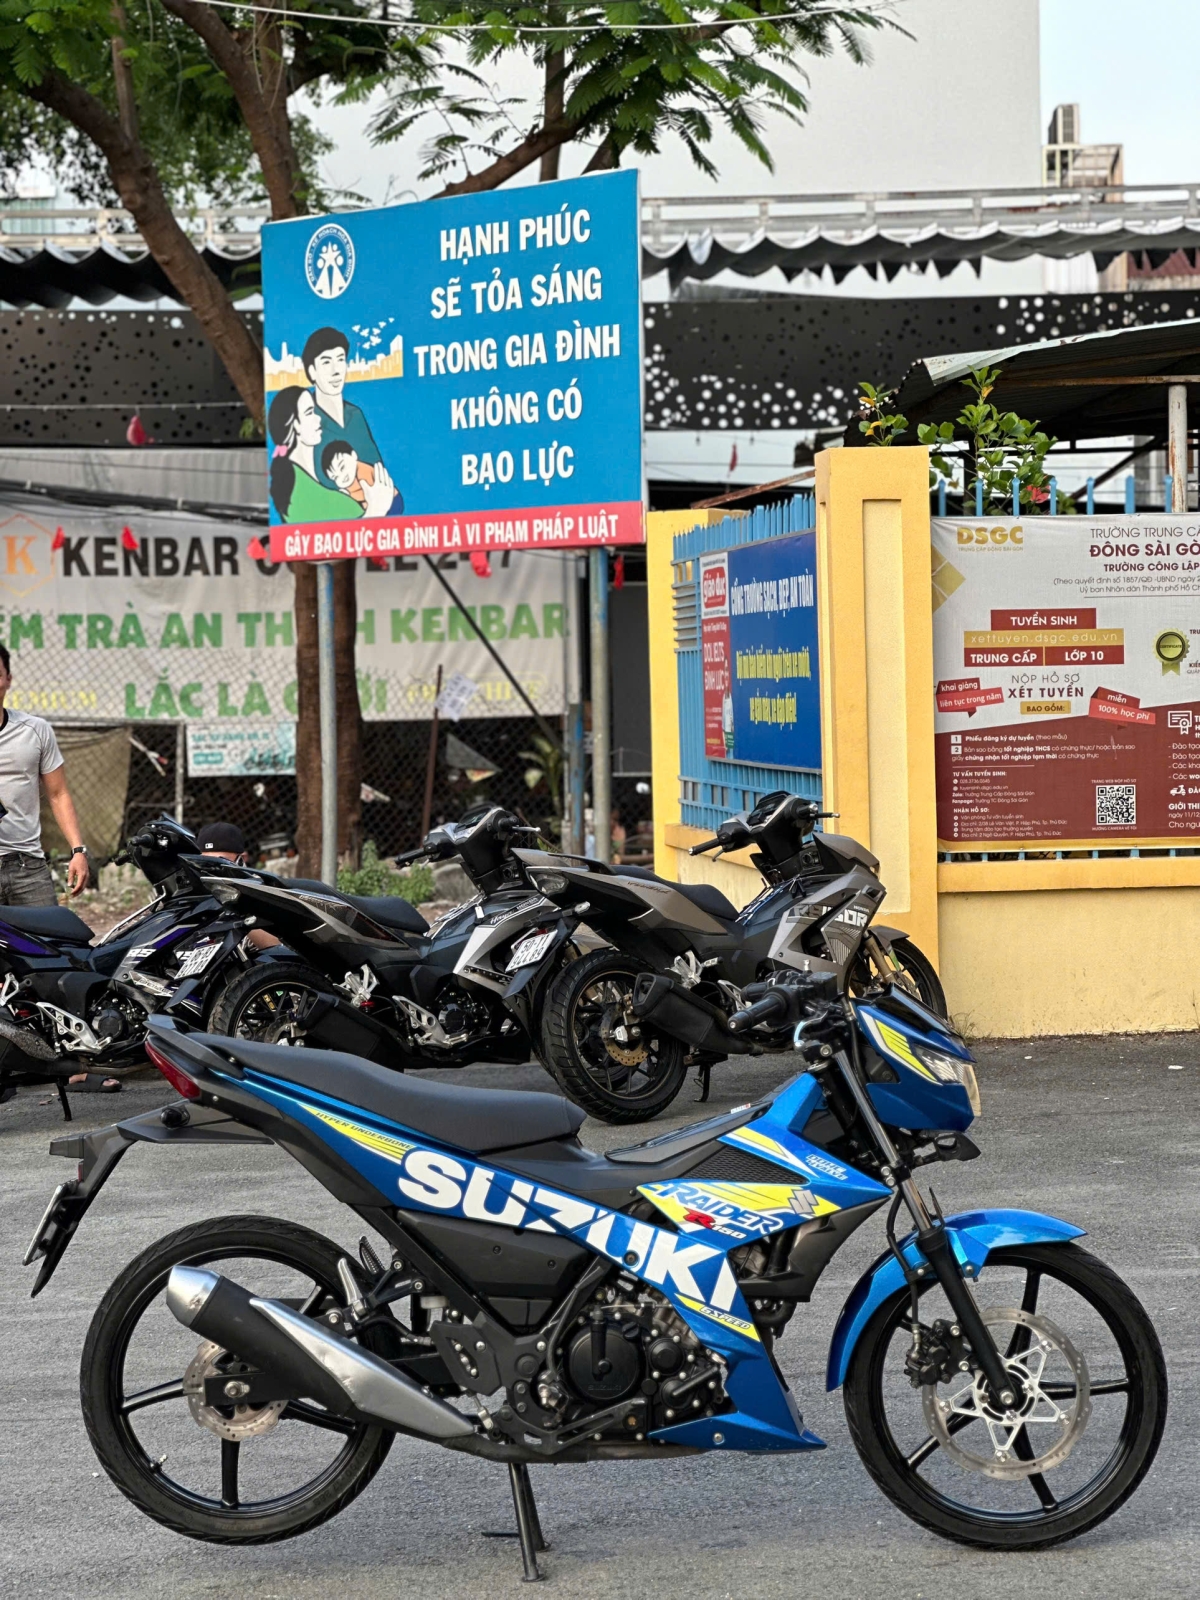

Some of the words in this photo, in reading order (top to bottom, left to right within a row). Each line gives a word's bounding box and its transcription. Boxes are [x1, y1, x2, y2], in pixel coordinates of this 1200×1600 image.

[440, 221, 509, 264] HẠNH
[519, 203, 590, 250] PHÚC
[430, 276, 462, 319] SẼ
[471, 267, 524, 313] TỎA
[530, 263, 602, 307] SÁNG
[414, 337, 498, 378] TRONG
[505, 334, 547, 368] GIA
[555, 320, 620, 363] ĐÌNH
[450, 386, 540, 430] KHÔNG
[546, 378, 583, 420] CÓ
[461, 450, 514, 490] BẠO
[522, 440, 575, 487] LỰC
[284, 529, 312, 558] GÂY
[313, 526, 343, 559] BẠO
[346, 523, 374, 555] LỰC
[376, 524, 401, 551] GIA
[404, 520, 439, 550] ĐÌNH
[442, 518, 462, 547] LÀ
[464, 521, 481, 546] VI
[484, 518, 528, 548] PHẠM
[532, 510, 575, 542] PHÁP
[578, 508, 619, 543] LUẬT
[957, 526, 1024, 544] DSGC
[1090, 526, 1140, 538] TRƯỜNG
[1144, 526, 1184, 538] TRUNG
[3, 535, 38, 575] K
[63, 536, 240, 577] KENBAR
[1090, 540, 1140, 558] ĐÔNG
[1144, 540, 1170, 556] SÀI
[1104, 561, 1145, 572] TRƯỜNG
[1148, 560, 1179, 571] CÔNG
[1182, 560, 1200, 572] LẬP
[1074, 576, 1094, 586] quyết
[58, 601, 148, 649] TRÀ
[160, 612, 222, 648] AN
[391, 603, 570, 644] KENBAR
[1010, 612, 1046, 626] TUYỂN
[1050, 616, 1078, 626] SINH
[971, 632, 1117, 644] xettuyen.dsgc.edu.vn
[970, 654, 1009, 664] TRUNG
[1012, 650, 1037, 663] CẤP
[1065, 649, 1087, 661] LỚP
[1091, 651, 1104, 660] 10
[941, 682, 956, 692] khai
[958, 681, 978, 691] giảng
[1012, 673, 1037, 685] NỘP
[1042, 671, 1059, 683] HỒ
[1064, 673, 1080, 683] SƠ
[125, 667, 204, 718] LẮC
[218, 671, 272, 718] LÀ
[1008, 686, 1033, 698] XÉT
[1040, 682, 1084, 698] TUYỂN
[1108, 694, 1127, 703] miễn
[940, 699, 952, 708] liên
[954, 698, 965, 706] tục
[966, 695, 985, 705] trong
[986, 693, 1001, 702] năm
[1098, 705, 1118, 714] 100%
[1120, 706, 1135, 718] học
[316, 1112, 349, 1128] HYPER
[351, 1125, 414, 1150] UNDERBONE
[655, 1183, 783, 1235] RAIDER
[397, 1150, 738, 1312] SUZUKI
